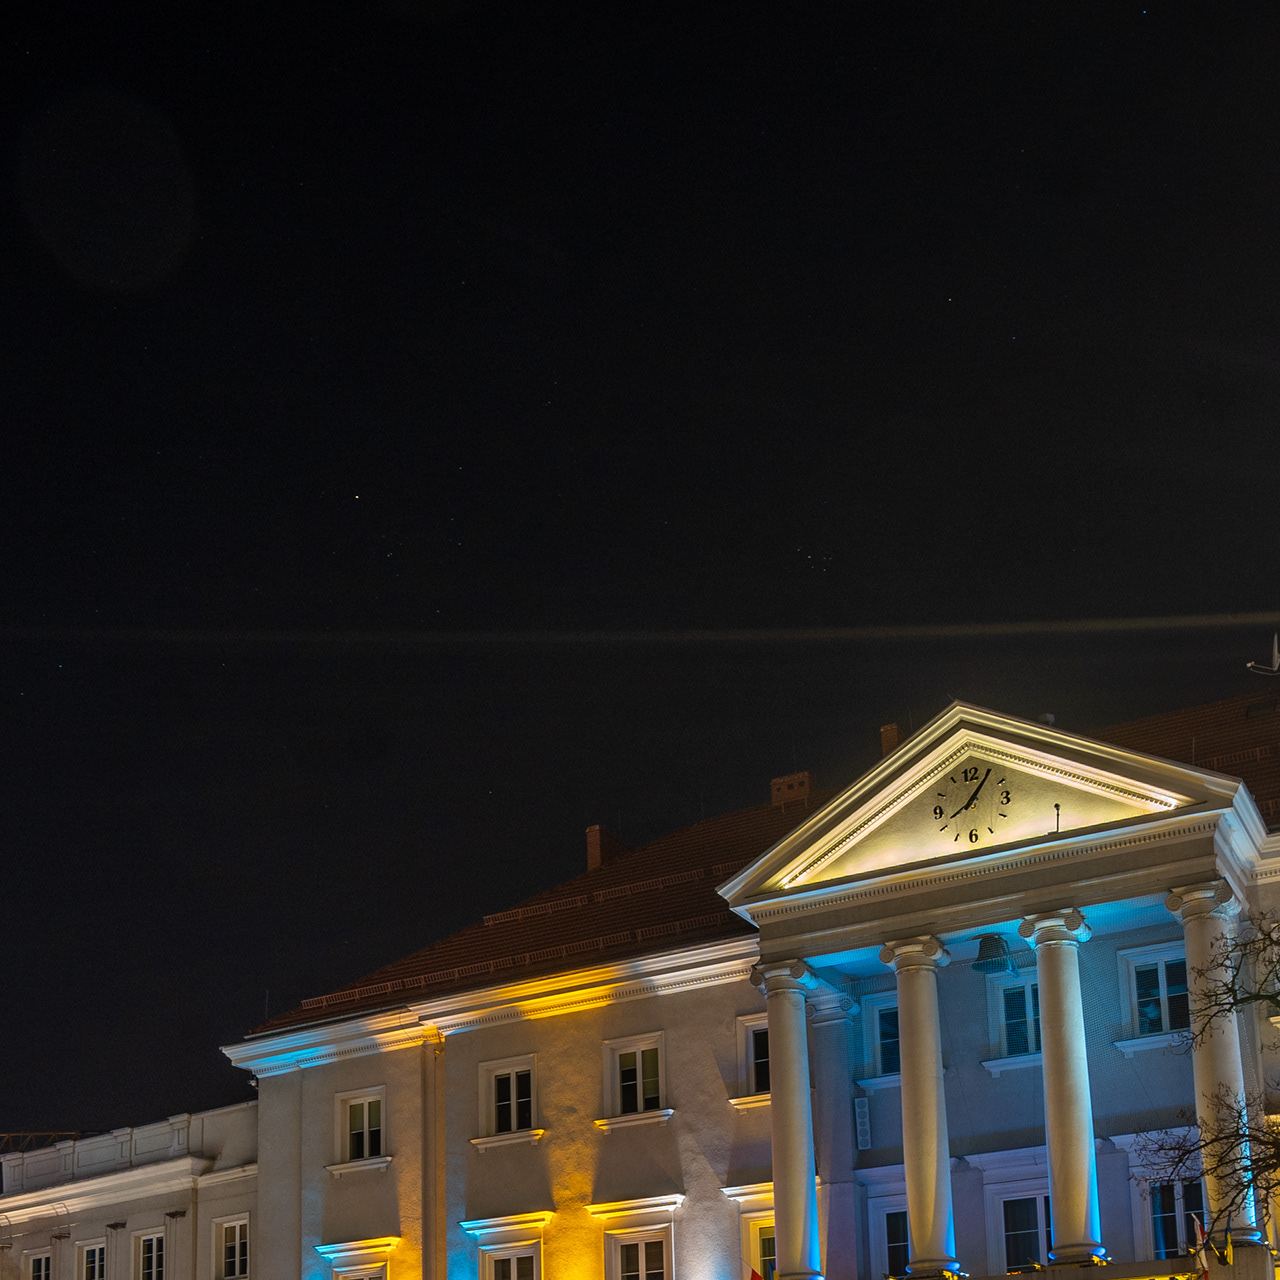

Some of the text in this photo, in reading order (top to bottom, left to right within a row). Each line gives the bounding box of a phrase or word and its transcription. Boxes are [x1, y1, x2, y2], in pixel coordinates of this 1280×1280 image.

[961, 767, 979, 782] 12
[1000, 791, 1011, 805] 3
[933, 805, 944, 820] 9
[969, 829, 979, 843] 6
